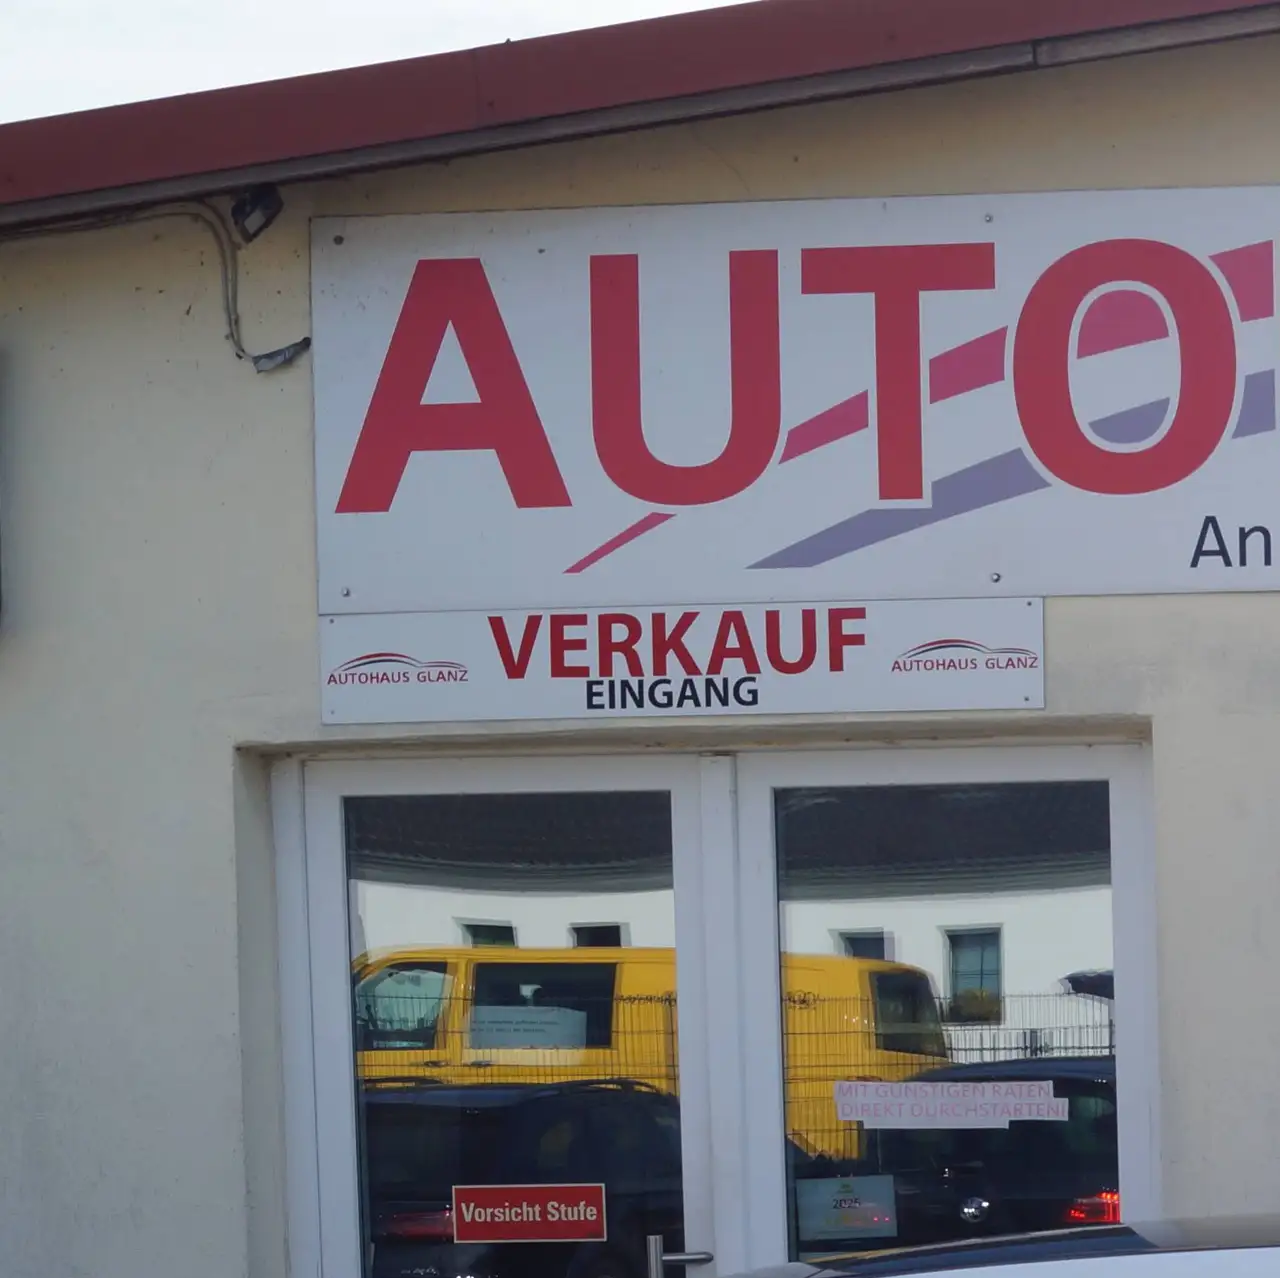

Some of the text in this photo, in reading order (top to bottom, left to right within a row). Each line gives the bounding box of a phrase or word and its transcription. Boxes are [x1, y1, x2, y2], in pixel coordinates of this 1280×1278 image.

[1189, 515, 1272, 568] An
[487, 607, 866, 679] VERKAUF
[891, 656, 1039, 673] AUTOHAUS GLANZ
[327, 669, 469, 685] AUTOHAUS GLANZ
[586, 676, 759, 710] EINGANG
[838, 1084, 867, 1098] MIT
[992, 1083, 1050, 1098] RATEN
[841, 1103, 903, 1118] DIREKT
[461, 1201, 598, 1223] Vorsicht Stufe
